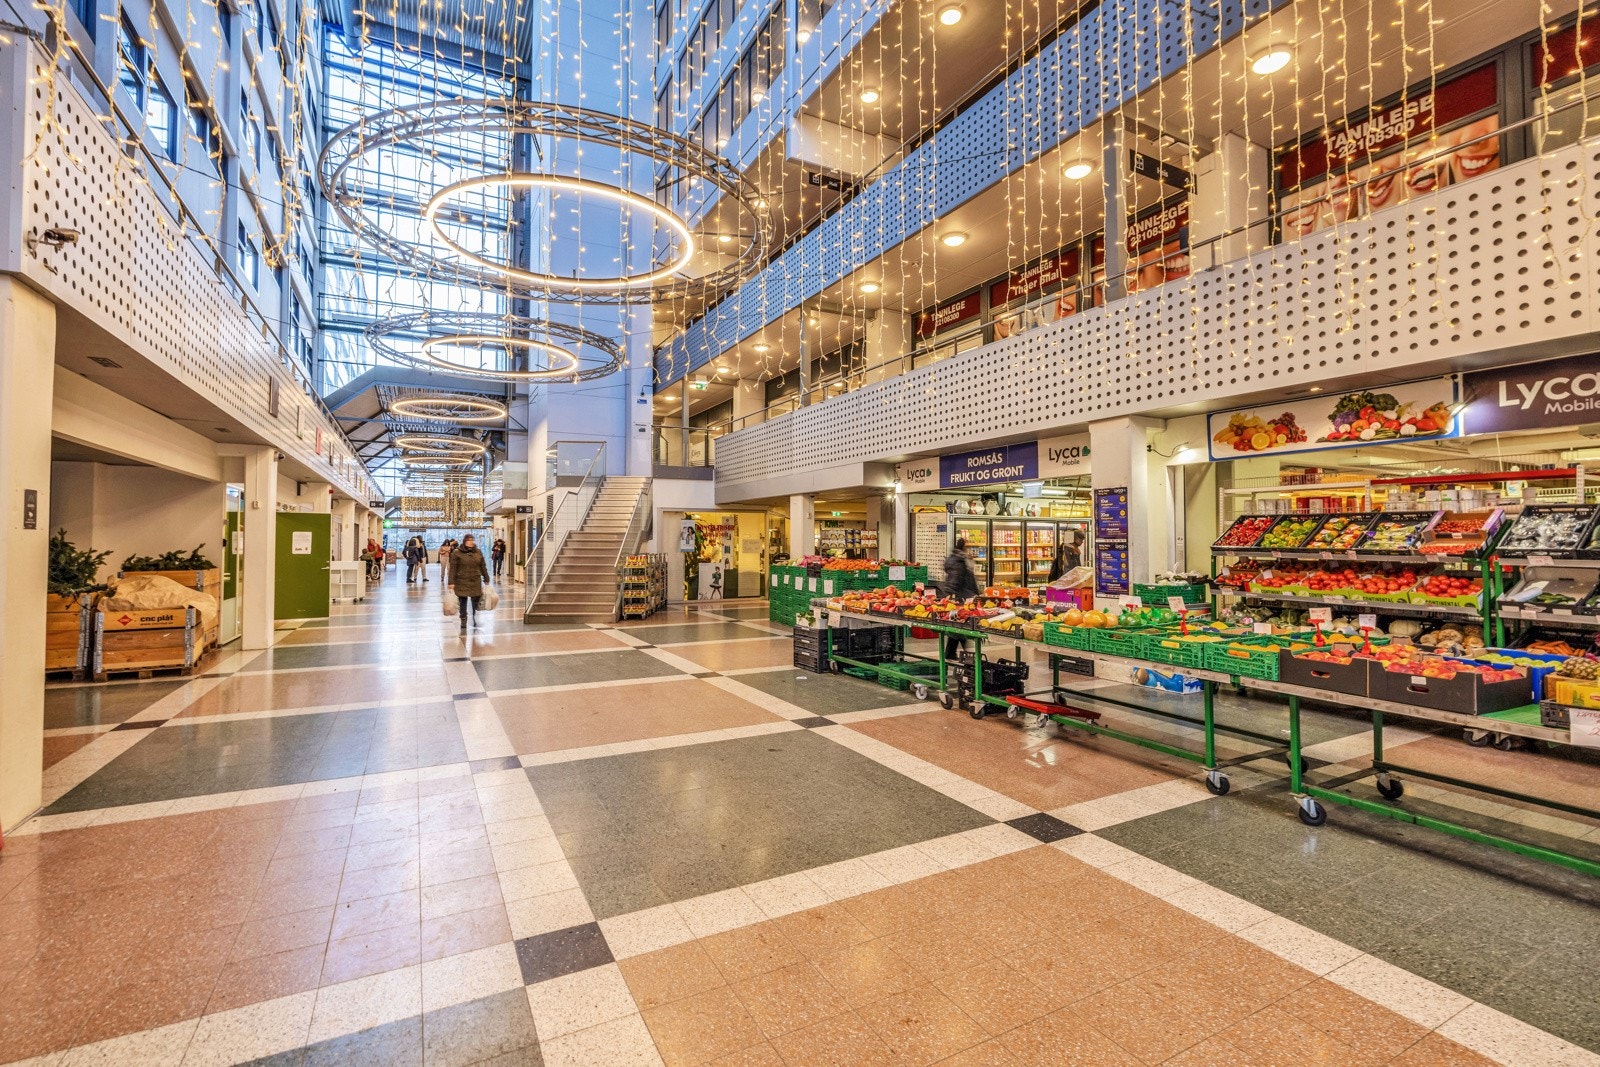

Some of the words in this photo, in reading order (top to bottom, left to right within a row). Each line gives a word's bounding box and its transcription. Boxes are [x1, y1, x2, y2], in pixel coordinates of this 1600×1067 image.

[1324, 94, 1434, 151] TANNLEGE
[1338, 118, 1415, 159] 22108300
[1128, 201, 1187, 238] ANNLEGE
[1020, 260, 1053, 279] TANNLEGE
[1498, 372, 1600, 410] Lyca
[967, 453, 1002, 468] ROMSÅS
[1048, 446, 1080, 463] Lyca
[1062, 459, 1080, 467] Mobile
[906, 468, 926, 480] Lyca
[950, 472, 976, 484] FRUKT
[977, 470, 990, 480] OG
[993, 464, 1024, 479] GRØNT
